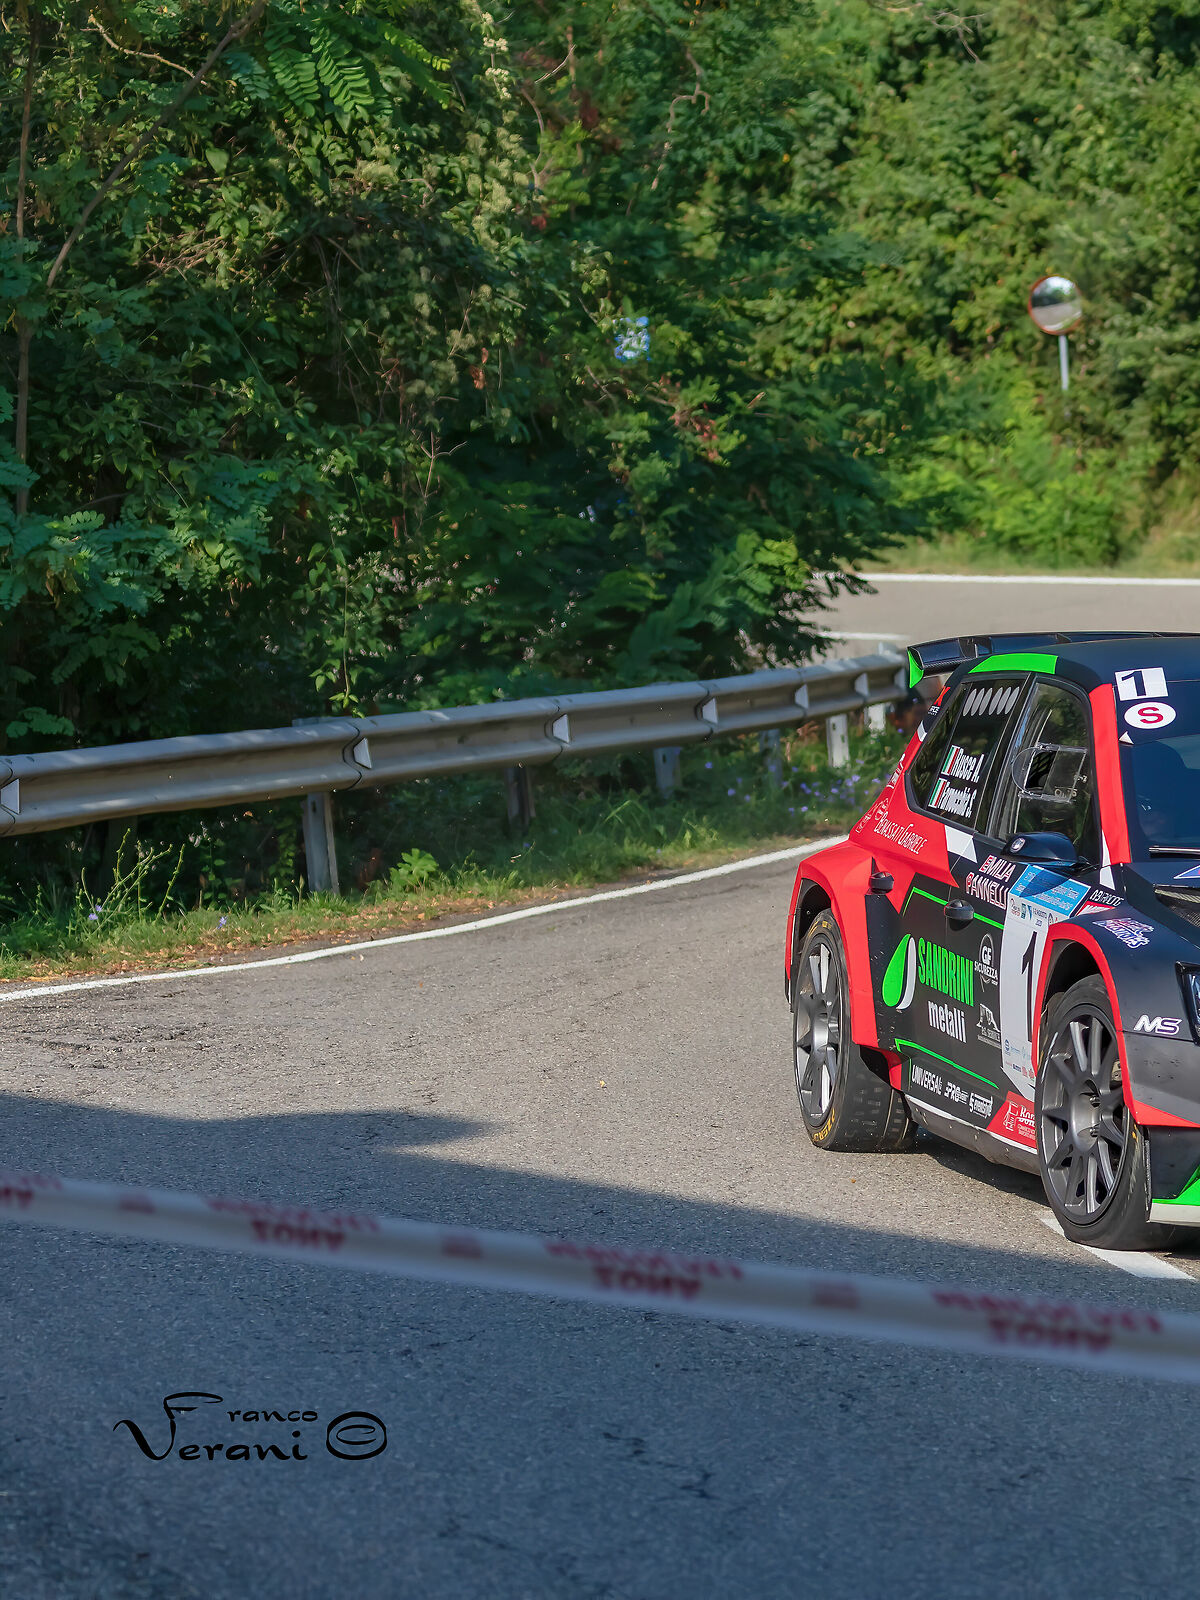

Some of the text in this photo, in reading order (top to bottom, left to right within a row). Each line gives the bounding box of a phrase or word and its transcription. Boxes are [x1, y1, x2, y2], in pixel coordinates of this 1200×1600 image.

[1120, 671, 1148, 697] 1
[1139, 706, 1164, 724] S
[918, 937, 975, 1007] SANDRINI
[1021, 931, 1038, 1043] 1
[927, 1000, 968, 1044] metalli
